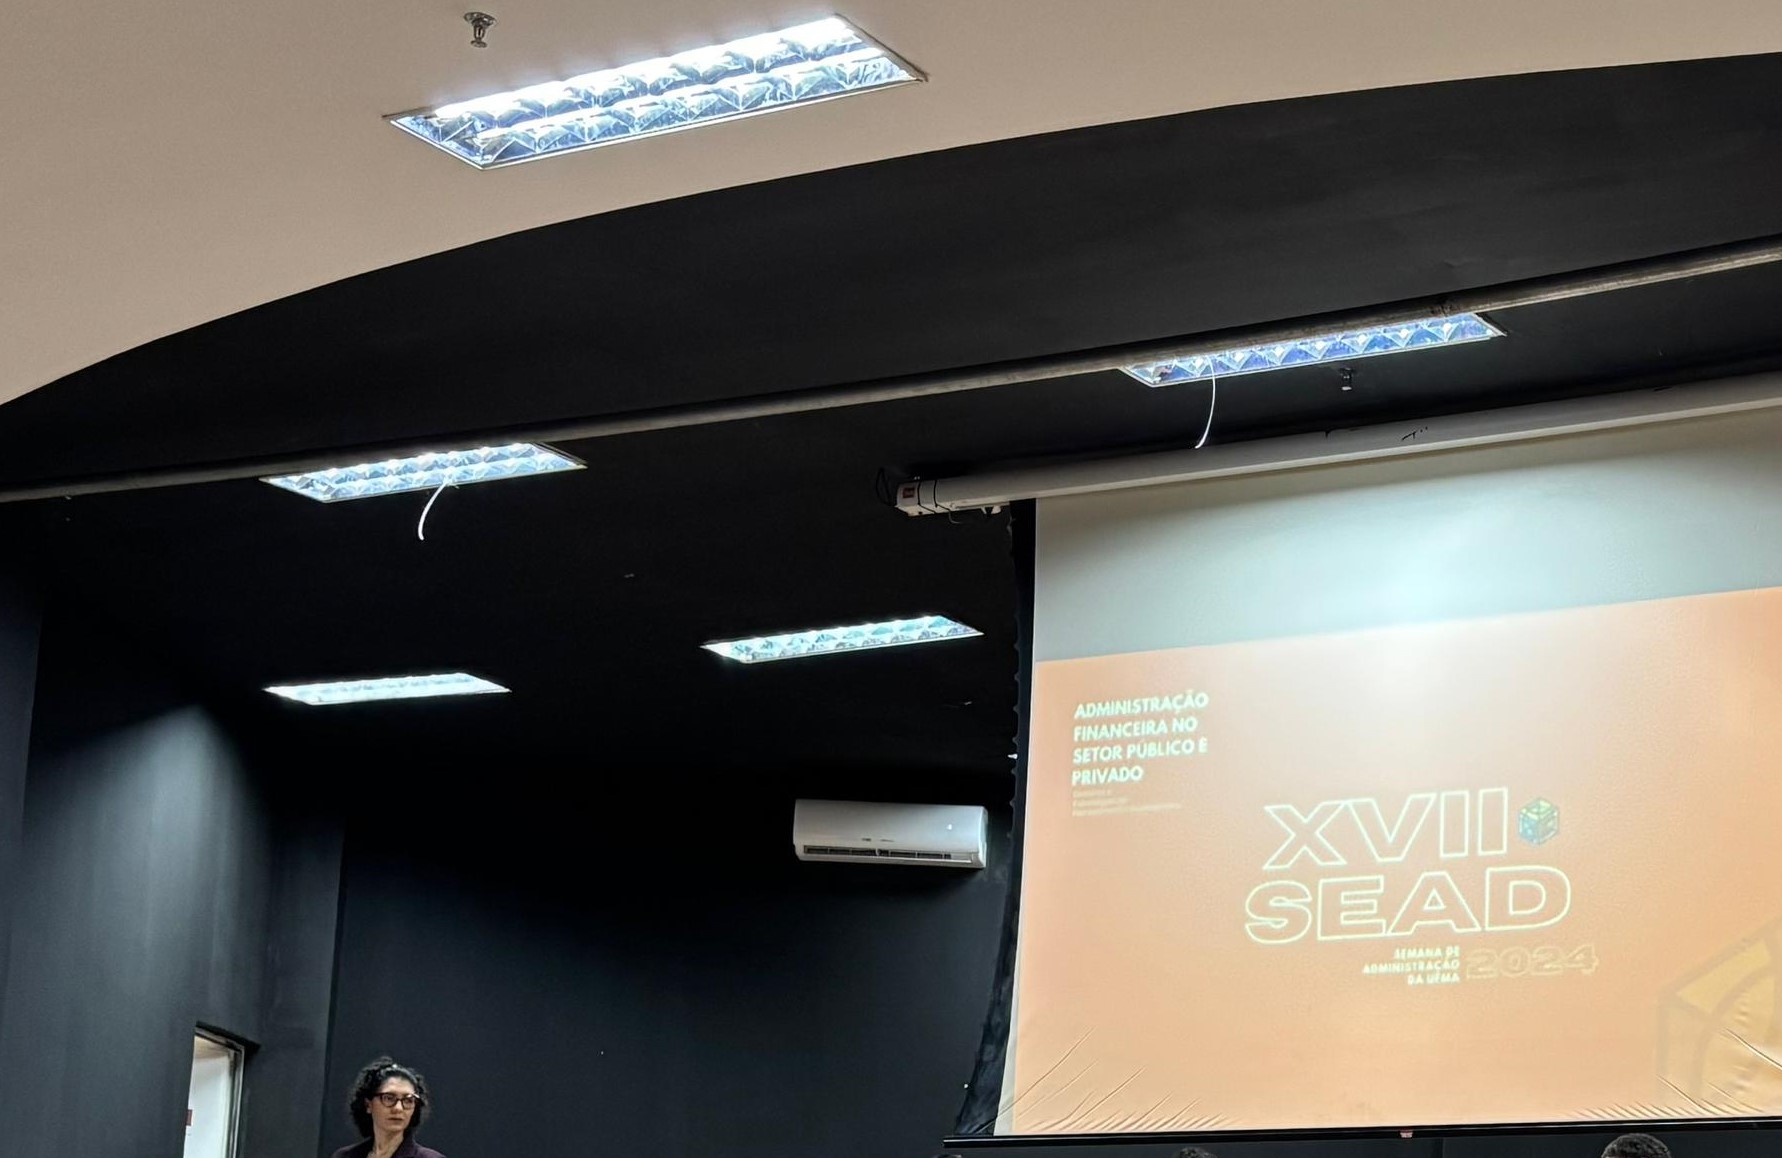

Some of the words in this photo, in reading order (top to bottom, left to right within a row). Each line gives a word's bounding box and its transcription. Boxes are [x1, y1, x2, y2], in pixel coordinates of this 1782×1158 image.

[1074, 689, 1210, 719] ADMINISTRAÇÃO
[1073, 721, 1168, 742] FINANCEIRA
[1172, 717, 1198, 733] NO
[1072, 745, 1122, 765] SETOR
[1126, 739, 1195, 760] PÚBLICO
[1198, 738, 1209, 753] E
[1072, 765, 1144, 786] PRIVADO
[1261, 786, 1509, 871] XVII
[1244, 865, 1572, 945] SEAD
[1393, 946, 1443, 959] SEMANA
[1445, 945, 1460, 957] DE
[1466, 944, 1600, 979] 2024
[1362, 959, 1460, 974] ADMINISTRAÇÃO
[1407, 974, 1423, 985] DA
[1427, 972, 1460, 984] UFMA
